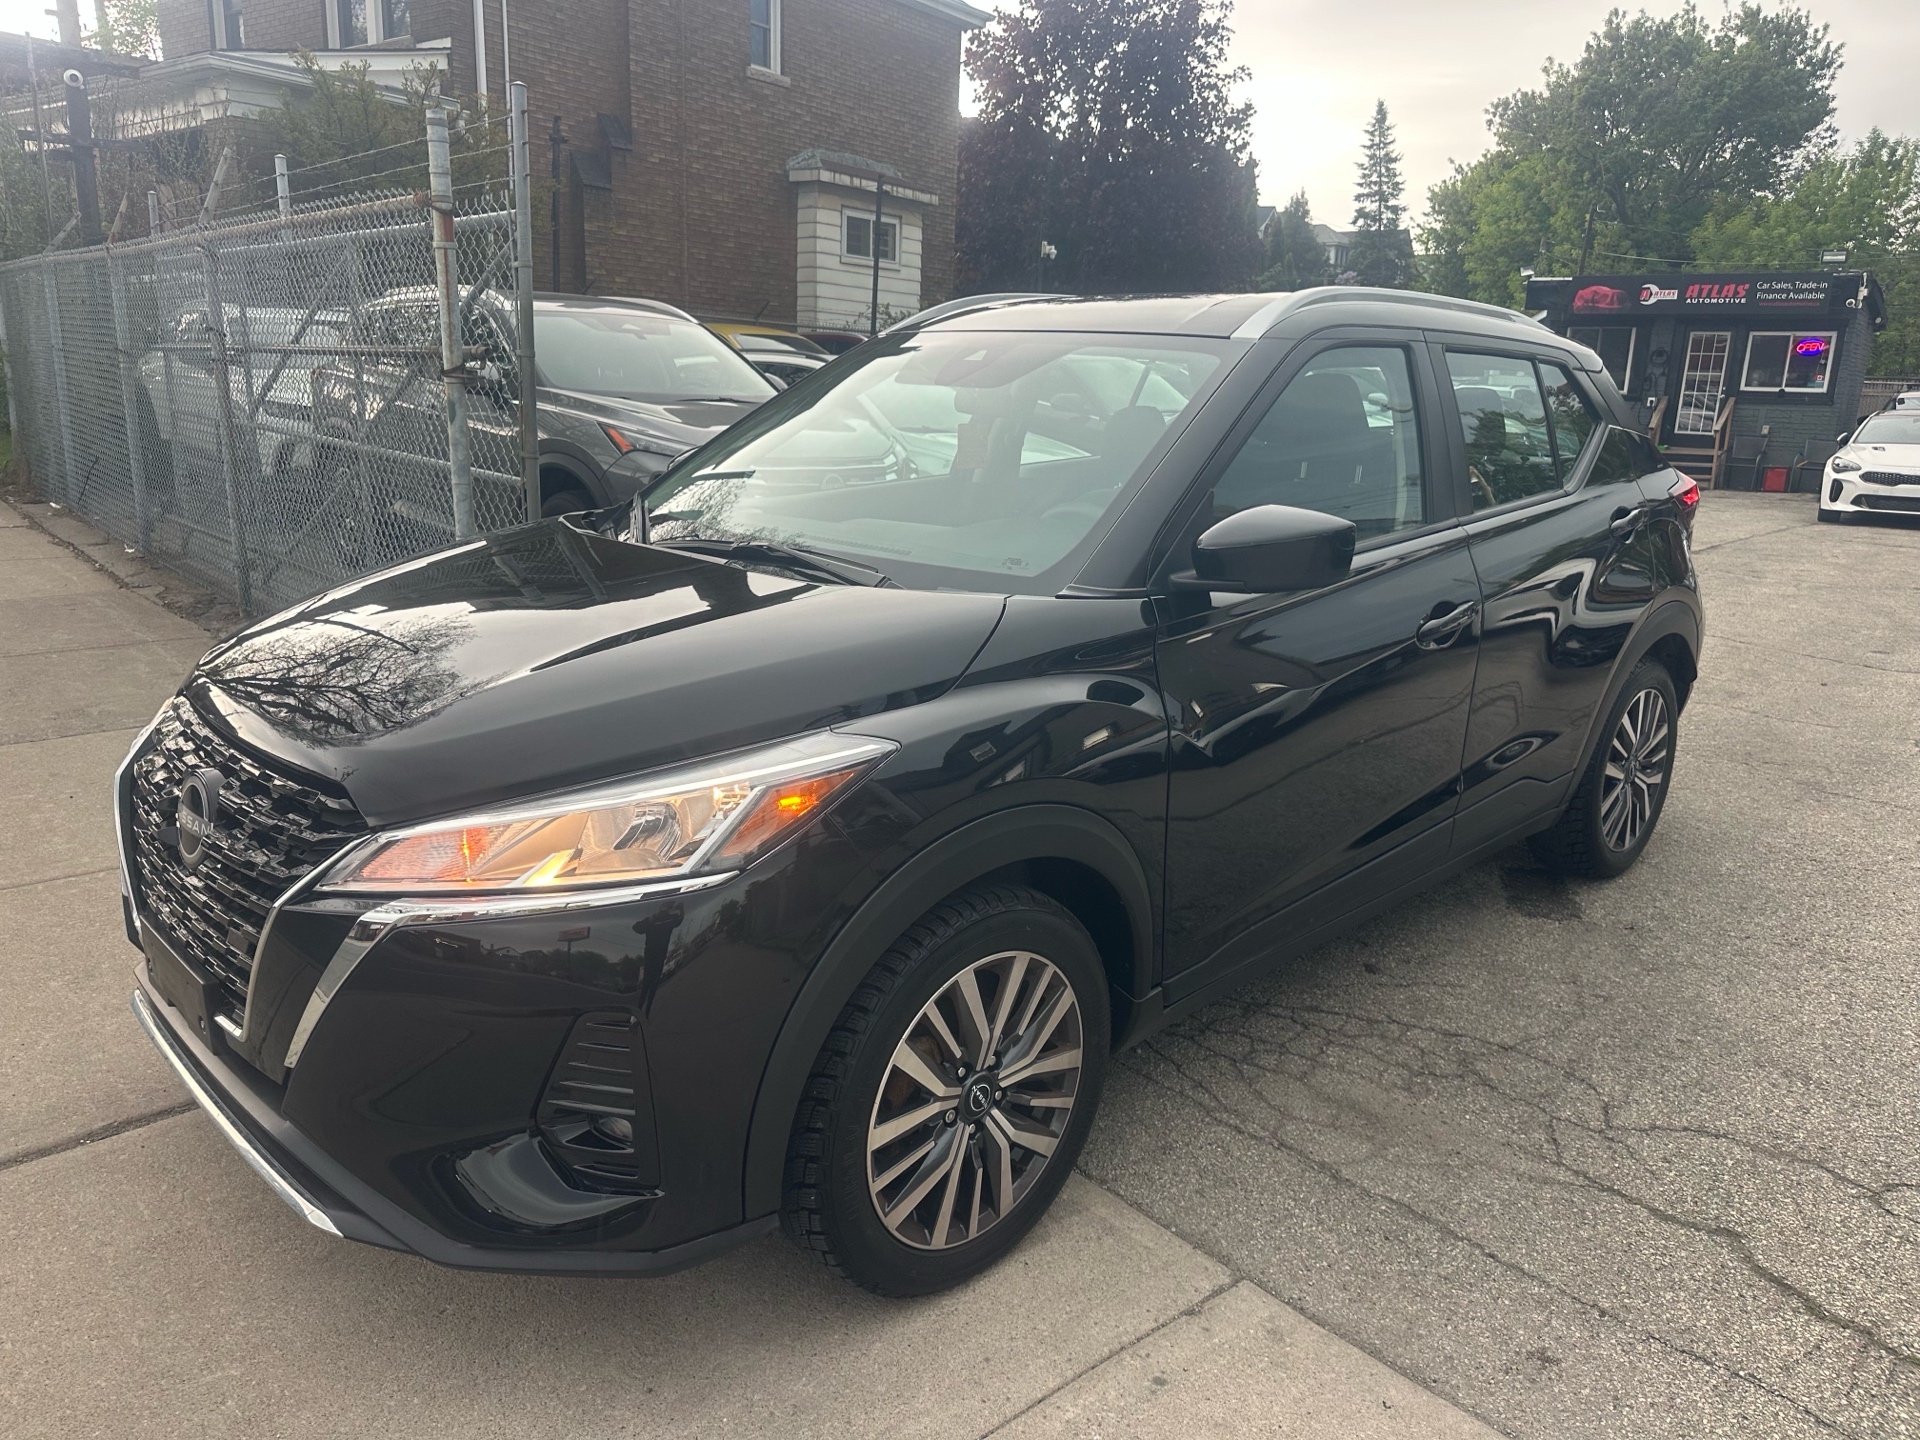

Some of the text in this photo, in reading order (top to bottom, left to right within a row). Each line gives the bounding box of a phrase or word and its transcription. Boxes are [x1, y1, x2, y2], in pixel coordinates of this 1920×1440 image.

[1757, 281, 1828, 290] Car Sales, Trade-in
[1686, 284, 1750, 298] ATLAS
[1756, 291, 1825, 299] Finance Available
[1797, 342, 1825, 352] OPEN
